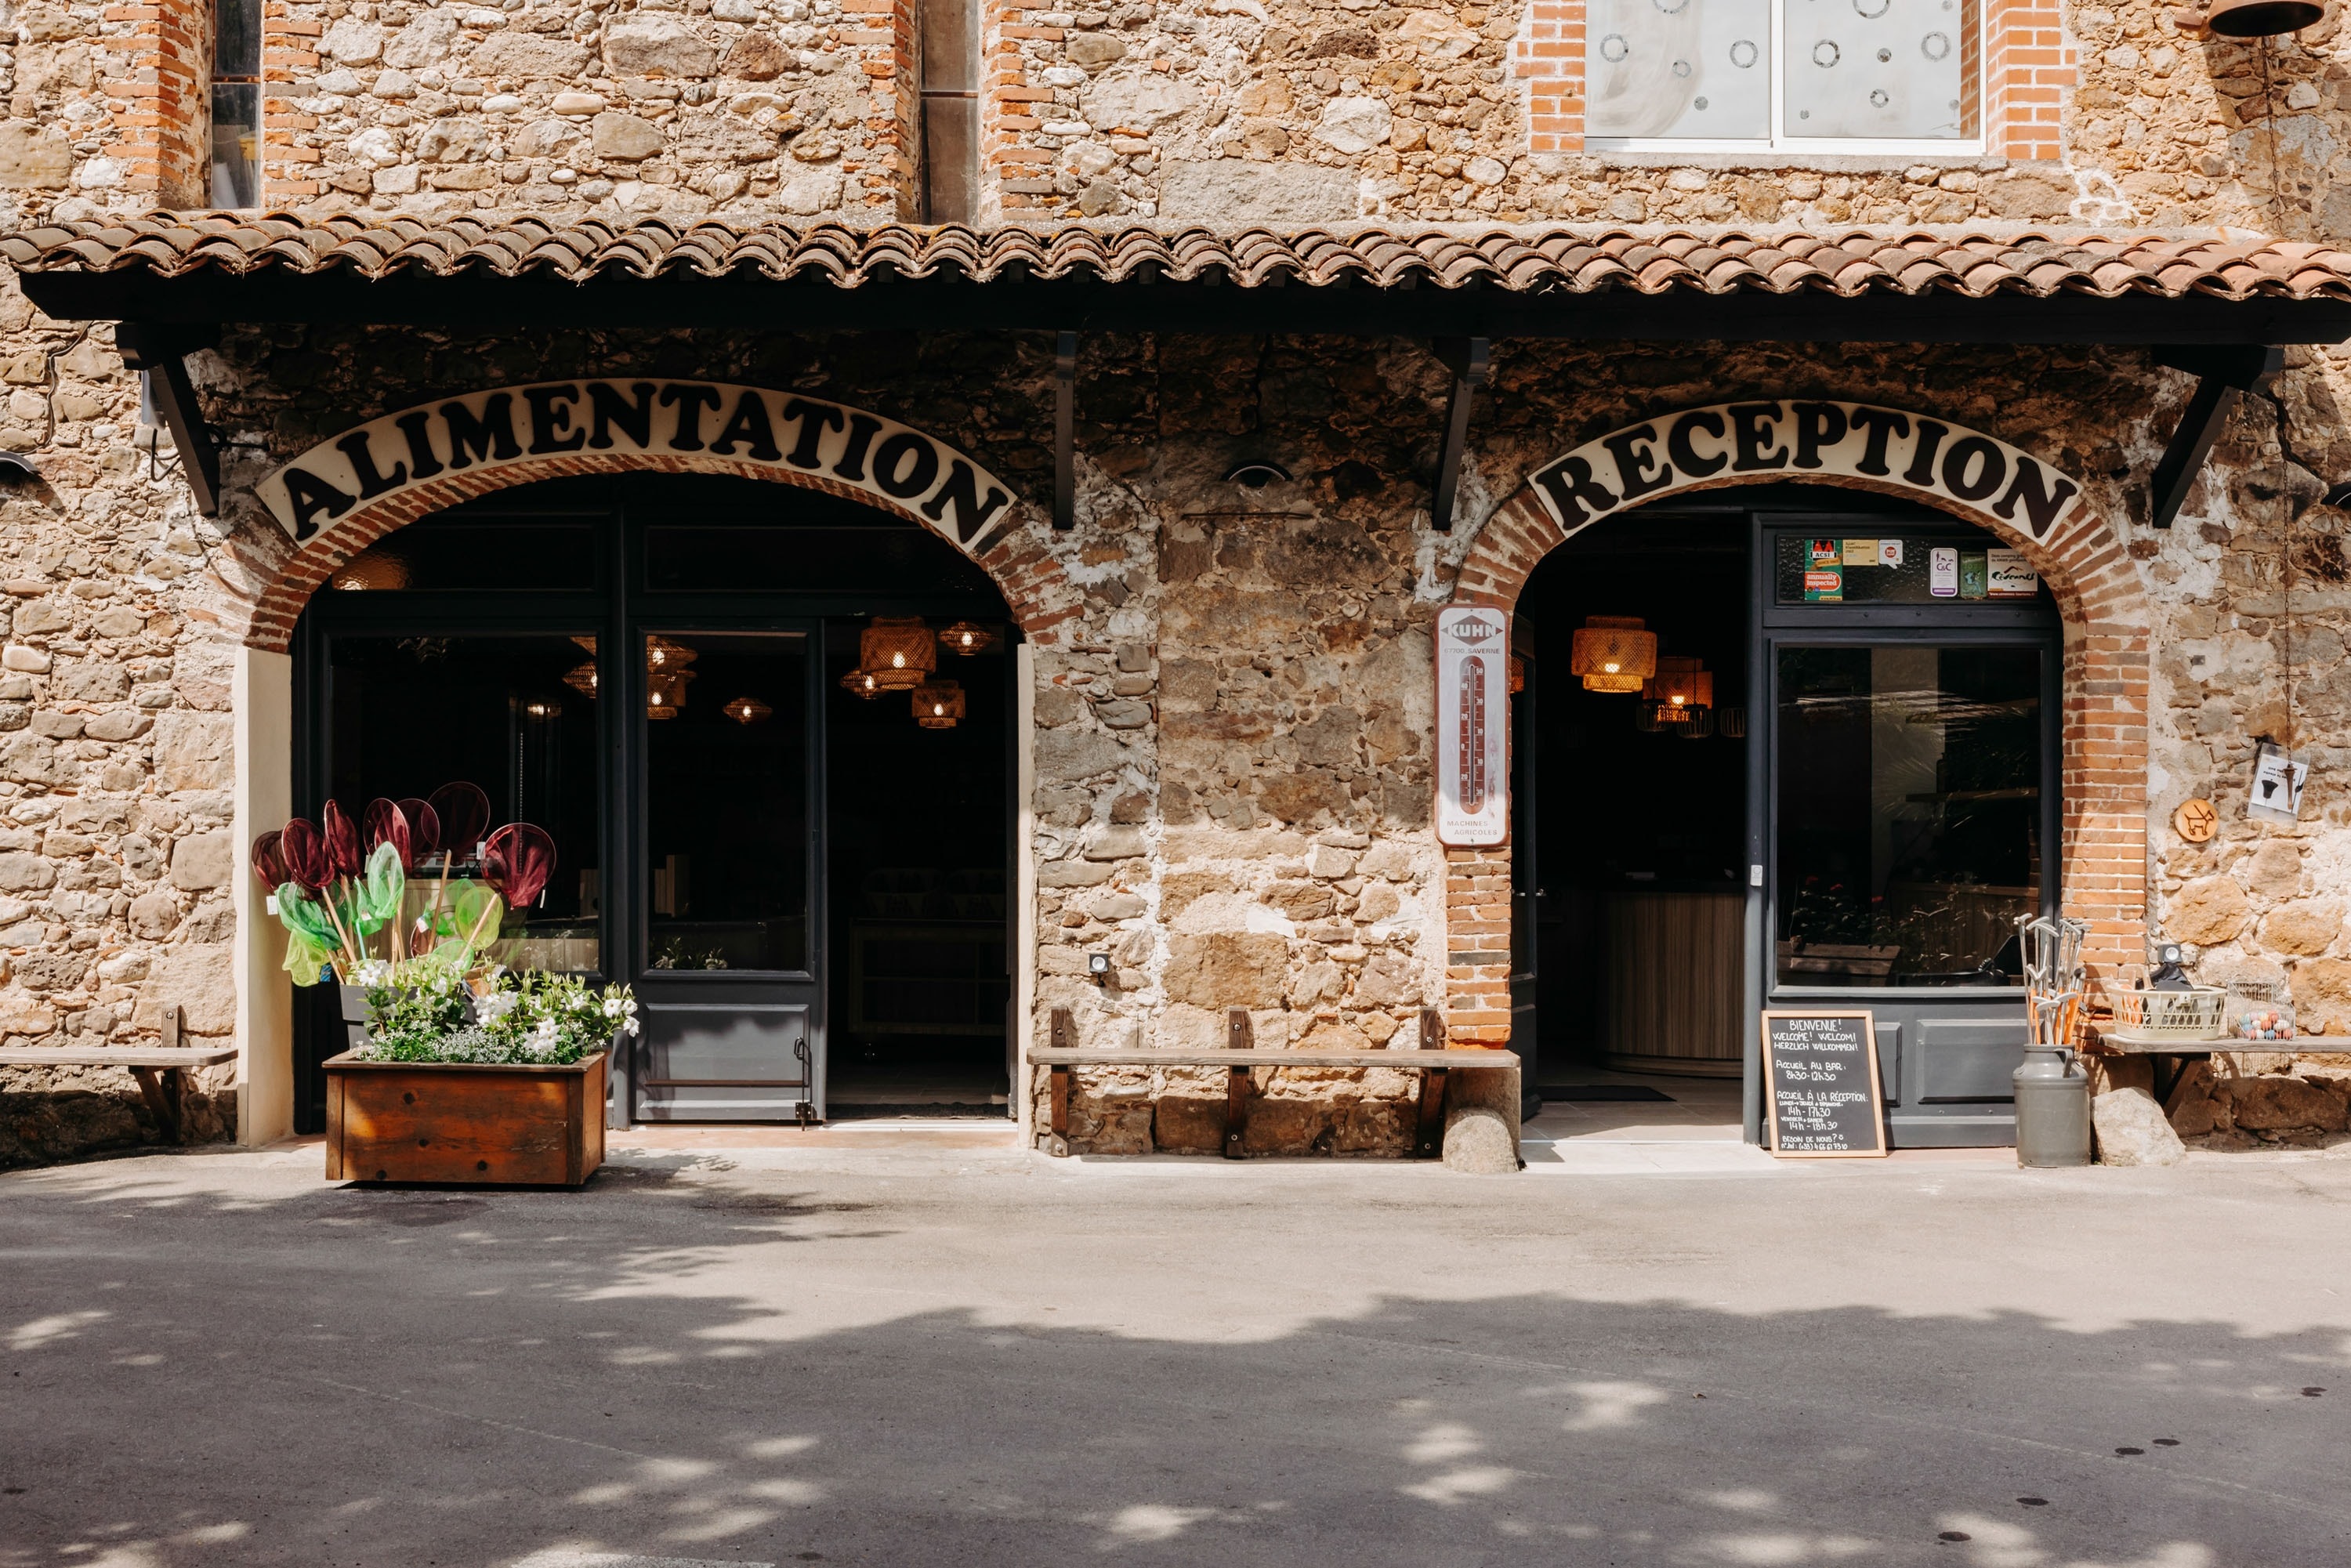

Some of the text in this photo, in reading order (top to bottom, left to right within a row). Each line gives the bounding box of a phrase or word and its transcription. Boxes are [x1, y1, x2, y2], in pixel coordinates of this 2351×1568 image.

[283, 382, 1009, 545] ALIMENTATION
[1534, 402, 2078, 539] RECEPTION
[1447, 624, 1497, 638] KUHN
[1773, 1041, 1809, 1051] HERZLICH
[1776, 1059, 1807, 1070] ACCUEIL
[1810, 1062, 1823, 1070] AU
[1777, 1090, 1804, 1100] ACCUEIL
[1807, 1089, 1814, 1101] À
[1817, 1092, 1828, 1101] LA
